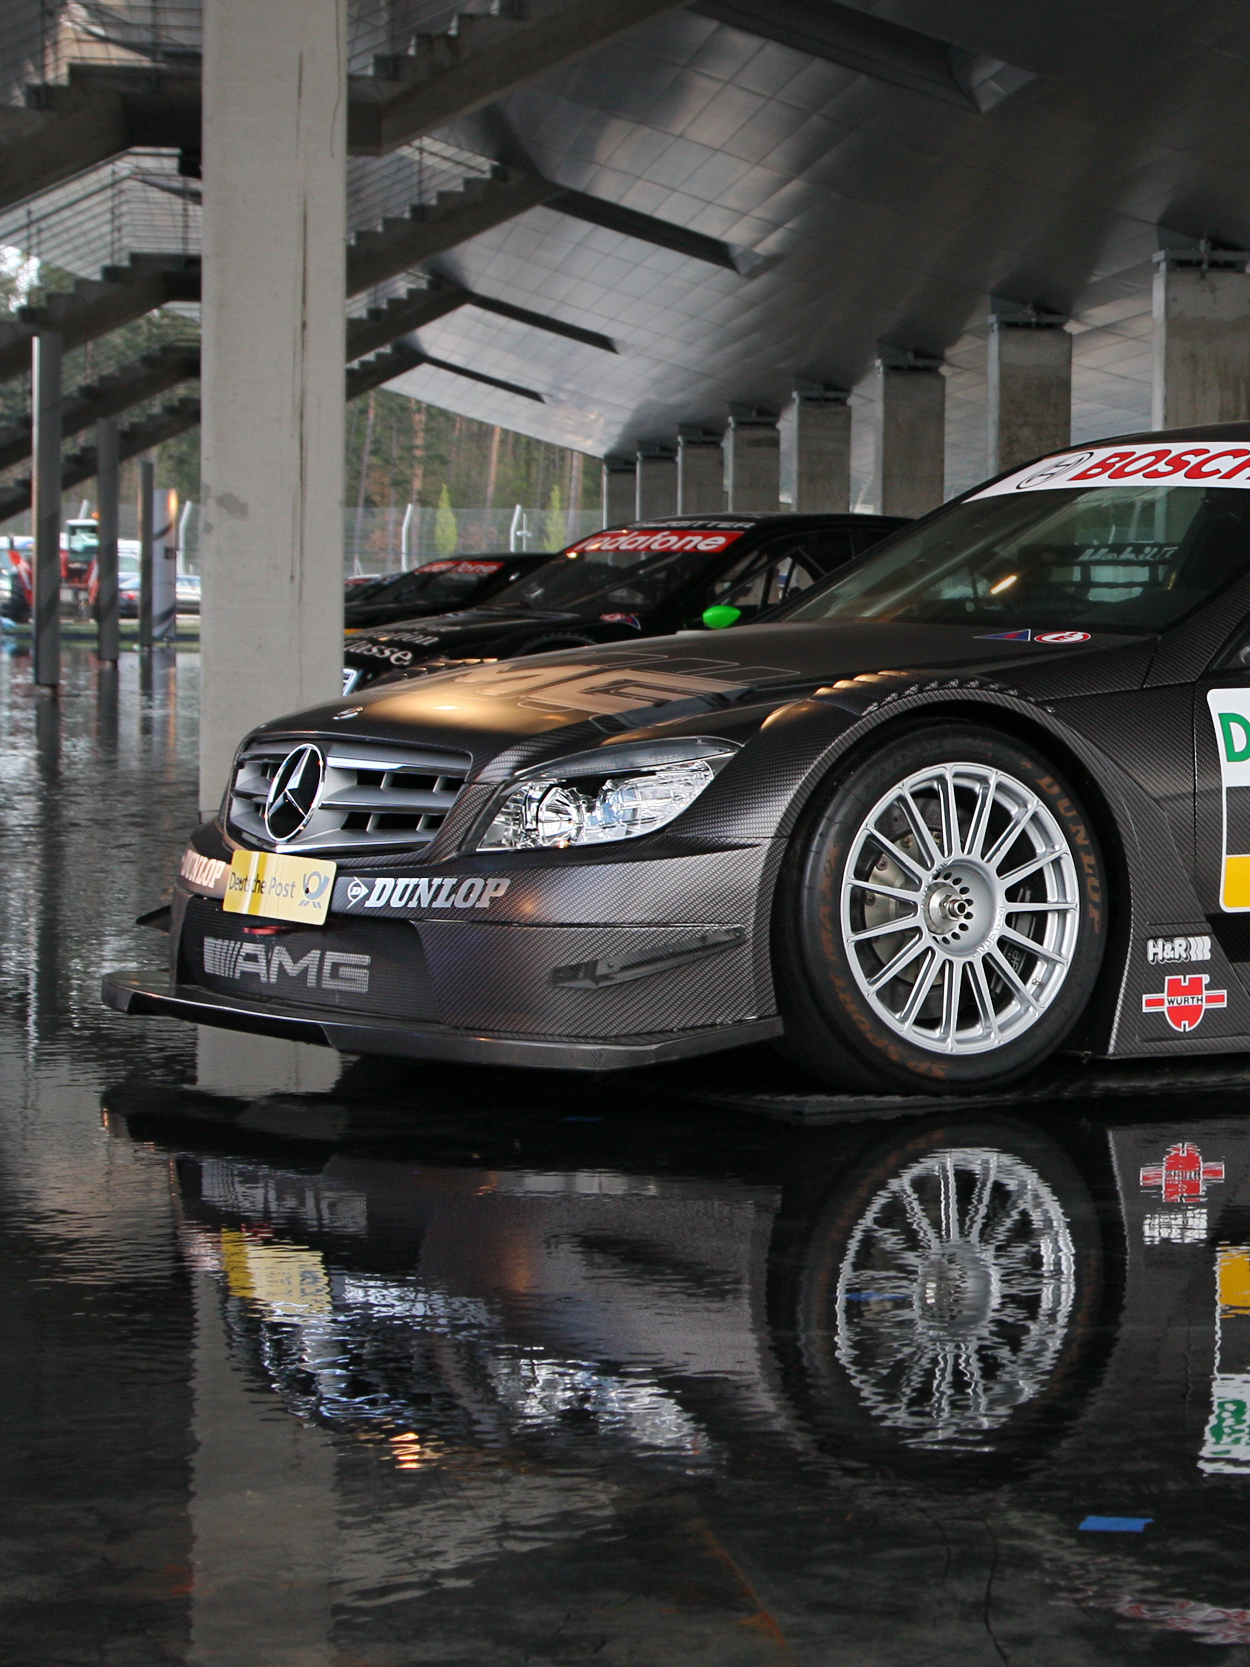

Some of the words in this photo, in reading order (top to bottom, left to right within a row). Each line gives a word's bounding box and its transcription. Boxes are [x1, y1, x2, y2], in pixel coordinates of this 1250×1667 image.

[574, 531, 727, 551] vodafone
[343, 639, 412, 666] lasse
[181, 849, 226, 889] DUNLOP
[229, 871, 266, 895] Deutsche
[268, 876, 296, 899] Post
[364, 877, 511, 908] DUNLOP
[1147, 937, 1190, 966] H&R
[233, 941, 372, 993] AMG
